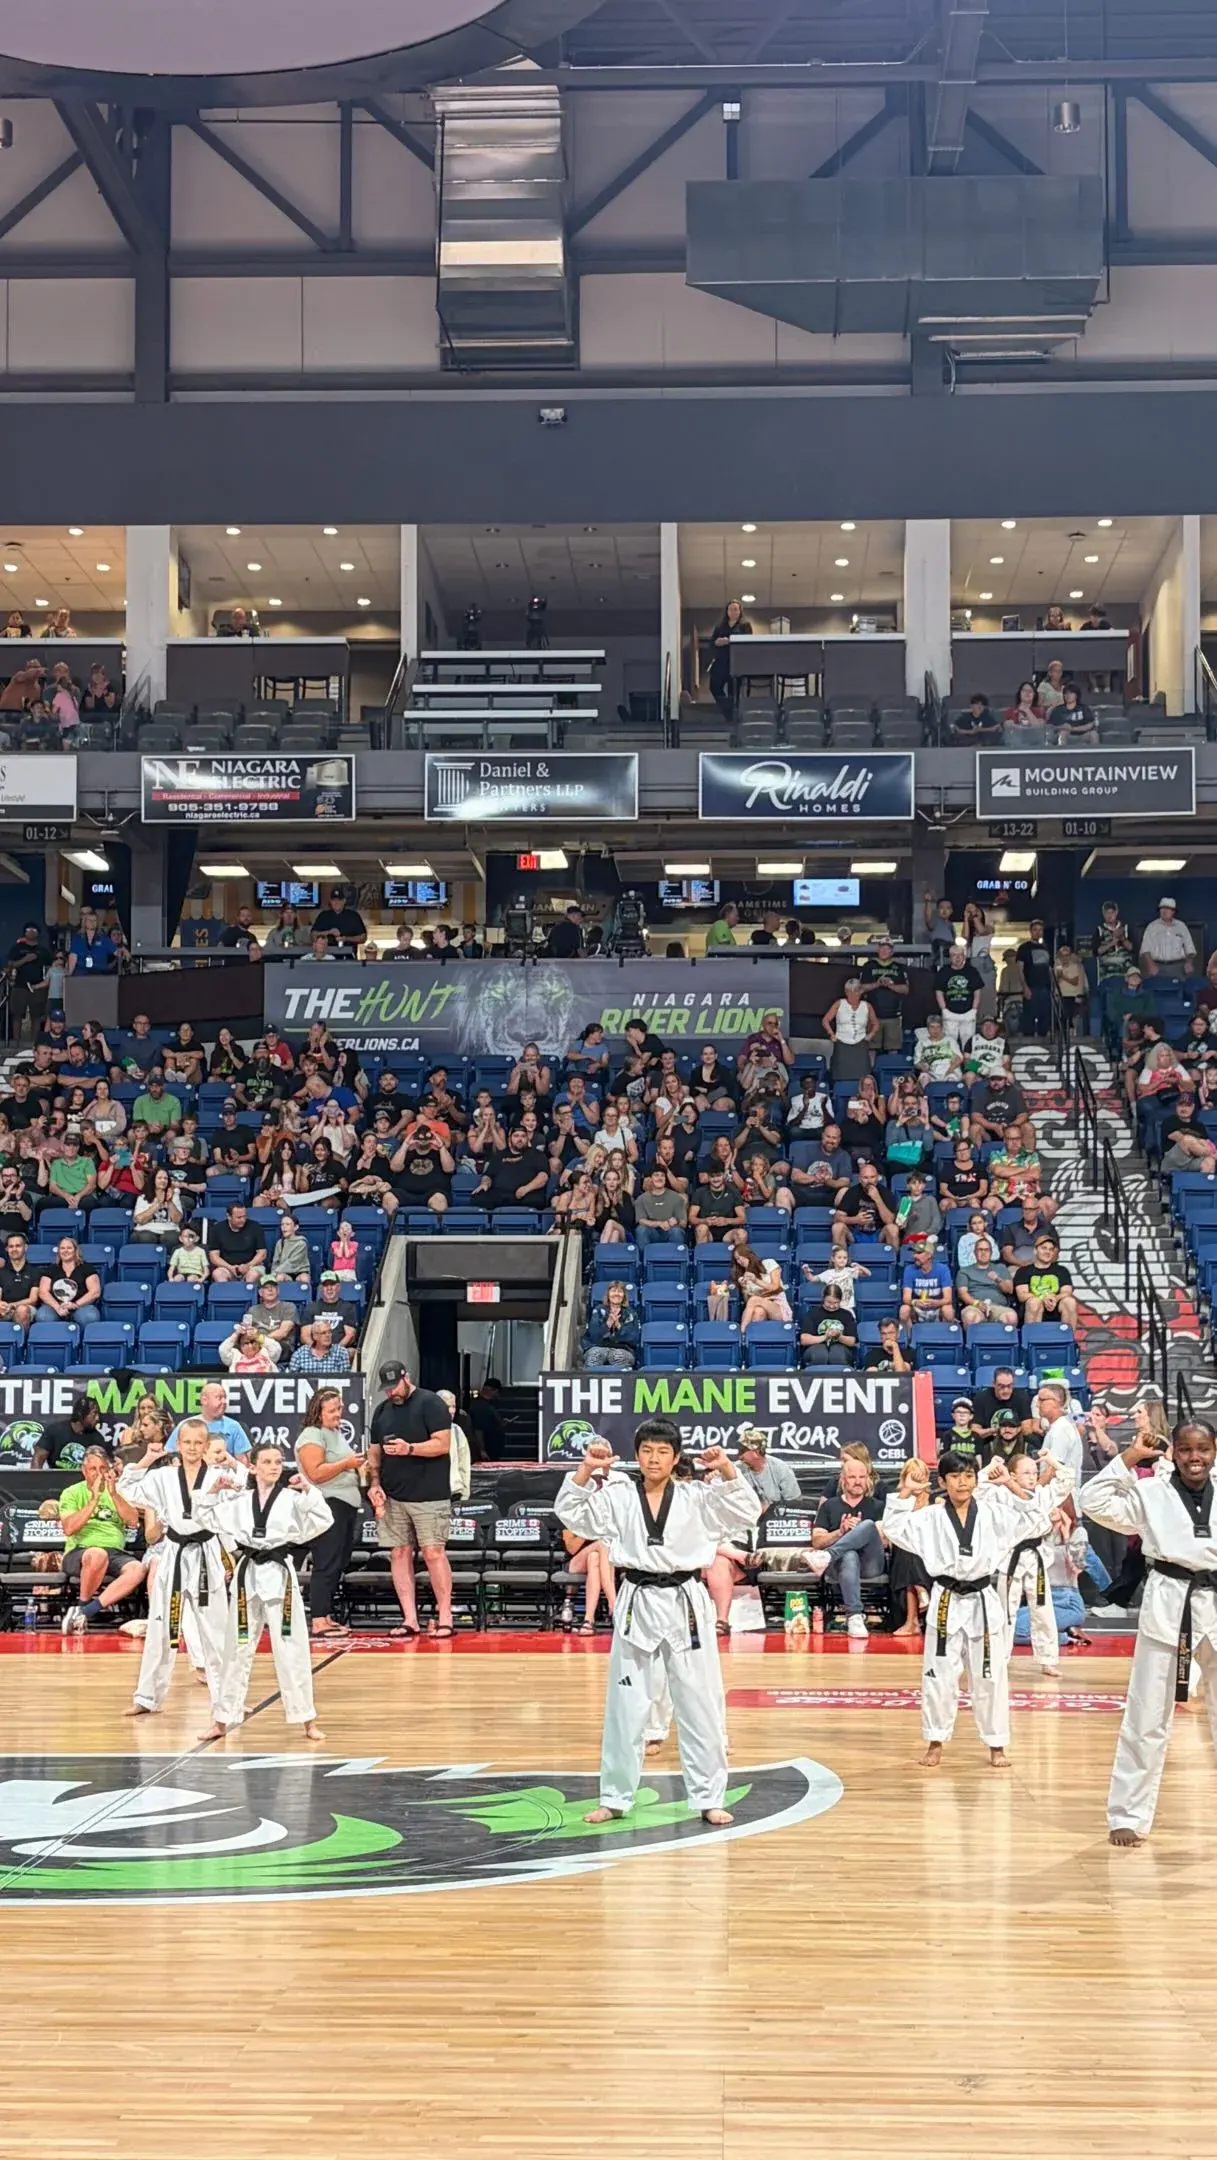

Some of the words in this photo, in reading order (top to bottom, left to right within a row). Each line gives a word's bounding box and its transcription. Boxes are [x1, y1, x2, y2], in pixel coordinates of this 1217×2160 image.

[211, 760, 300, 774] NIAGARA
[480, 762, 531, 778] Daniel
[536, 764, 550, 778] &
[1025, 765, 1178, 783] MOUNTAINVIEW
[480, 781, 551, 797] Partners
[556, 784, 584, 796] LLP
[740, 760, 873, 810] Rinaldi
[1025, 787, 1077, 796] BUILDING
[1081, 786, 1118, 795] GROUP
[800, 804, 861, 813] HOMES
[185, 812, 260, 820] niagaraelectric.ca
[26, 827, 57, 840] 01-12
[1002, 824, 1034, 836] 13-22
[1065, 822, 1096, 835] 01-10
[976, 880, 1001, 889] GRAB
[1014, 880, 1028, 889] GO
[738, 900, 787, 909] AMETIME
[284, 988, 361, 1019] THE
[354, 980, 466, 1026] HUNT
[633, 993, 751, 1006] NIAGARA
[600, 1007, 689, 1034] RIVER
[1011, 1045, 1115, 1090] GO
[1028, 1109, 1135, 1158] GO
[0, 1379, 75, 1415] THE
[86, 1378, 209, 1414] MANE
[546, 1378, 623, 1414] THE
[633, 1378, 757, 1414] MANE
[768, 1378, 910, 1414] EVENT.
[681, 1424, 735, 1448] EADY
[736, 1421, 779, 1449] ST
[780, 1421, 842, 1449] ROAR
[877, 1448, 908, 1459] CEBL
[495, 1519, 527, 1528] CRIME
[766, 1520, 798, 1528] CRIME
[23, 1528, 65, 1537] STOPPER
[495, 1527, 540, 1537] STOPPERS
[766, 1528, 812, 1537] STOPPERS
